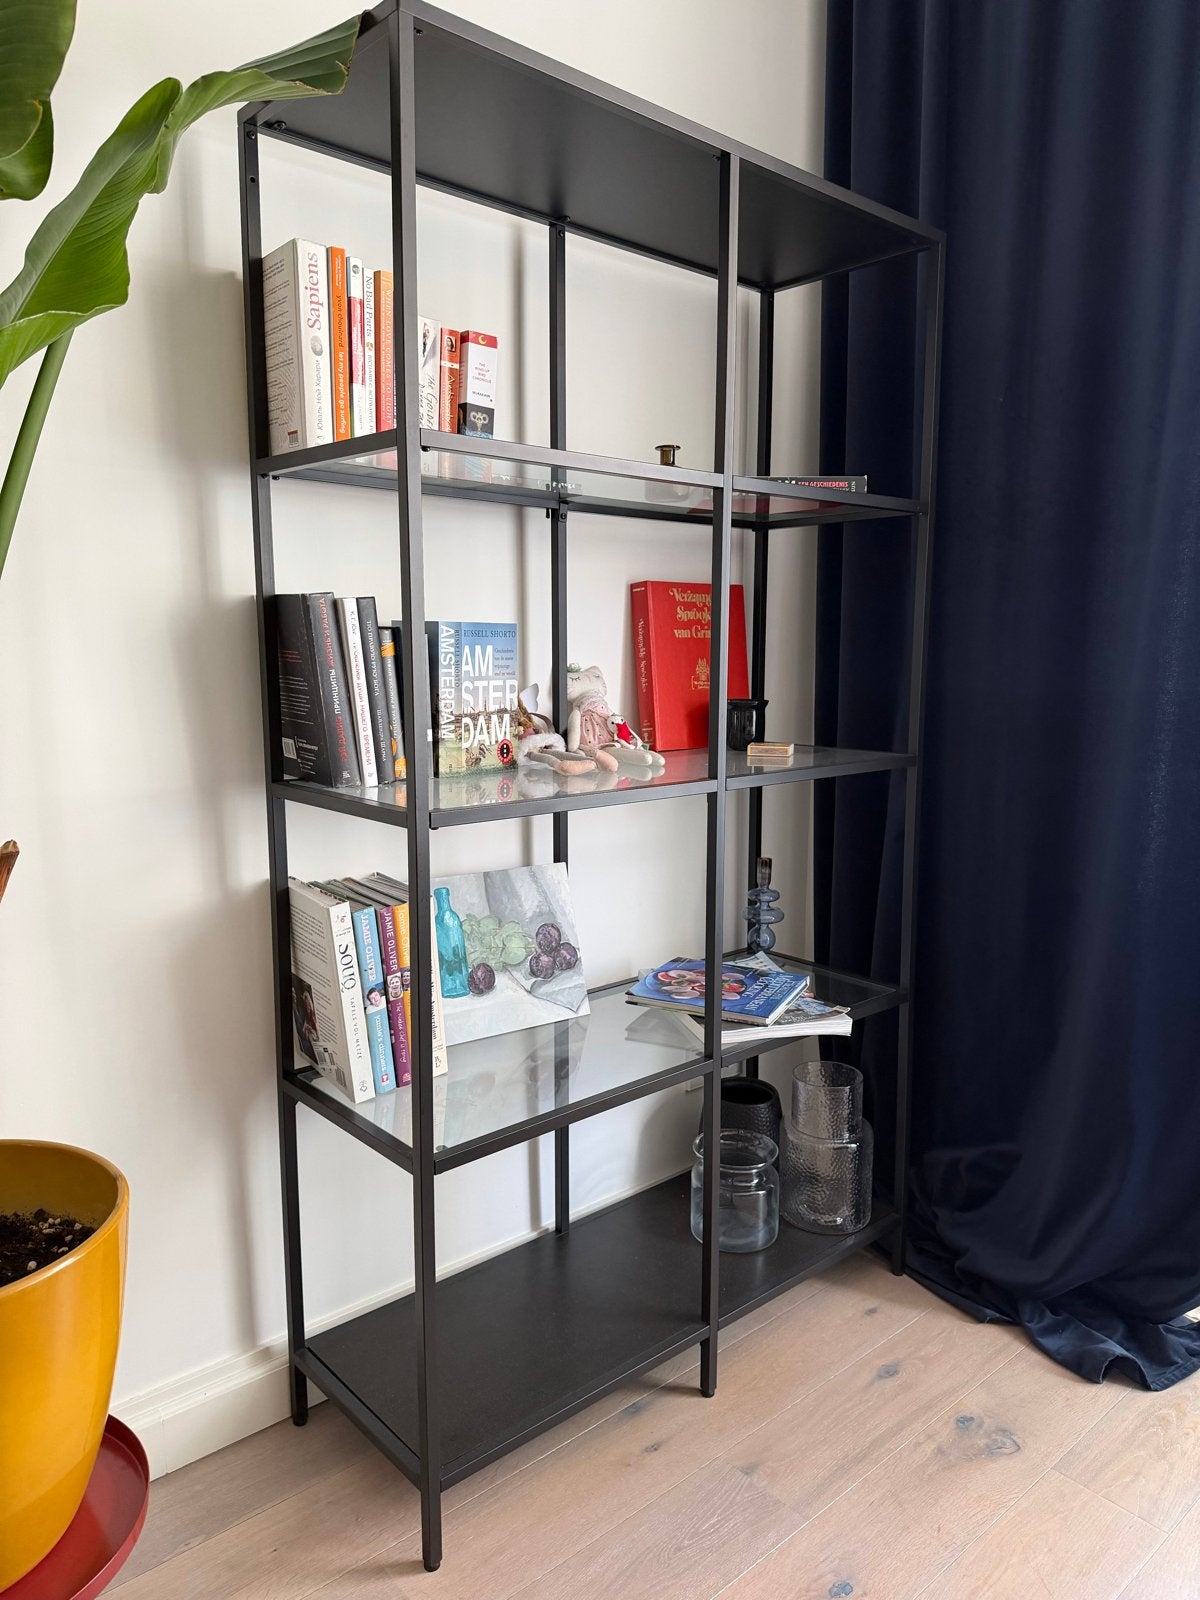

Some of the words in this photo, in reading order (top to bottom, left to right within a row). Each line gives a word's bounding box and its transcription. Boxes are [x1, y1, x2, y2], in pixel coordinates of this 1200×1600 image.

[304, 252, 324, 331] Sapiens
[365, 276, 373, 289] No
[336, 295, 344, 312] yvon
[365, 290, 373, 310] Bad
[337, 313, 345, 348] chouinard
[365, 311, 373, 337] Parts
[338, 362, 344, 374] my
[338, 375, 346, 399] people
[386, 382, 393, 395] TO
[339, 400, 346, 409] go
[339, 410, 347, 434] surfing
[318, 597, 328, 629] РАБОТА
[366, 620, 373, 632] ПО
[367, 633, 376, 662] ПРАВУЮ
[463, 629, 489, 638] RUSSELL
[490, 629, 516, 638] SHORTO
[673, 629, 691, 638] van
[325, 636, 335, 667] ЖИЗНЬ
[462, 644, 493, 677] AM
[329, 669, 341, 714] ПРИНЦИПЫ
[440, 625, 455, 739] AMSTERDAM
[462, 679, 519, 714] STER
[359, 704, 368, 732] НАШЕГО
[462, 714, 511, 749] DAM
[363, 734, 371, 766] ВРЕМЕНИ
[361, 914, 372, 945] JAMIE
[384, 911, 394, 938] JAMIE
[338, 943, 356, 994] SOUQ
[365, 945, 377, 982] OLIVER
[387, 939, 399, 972] OLIVER
